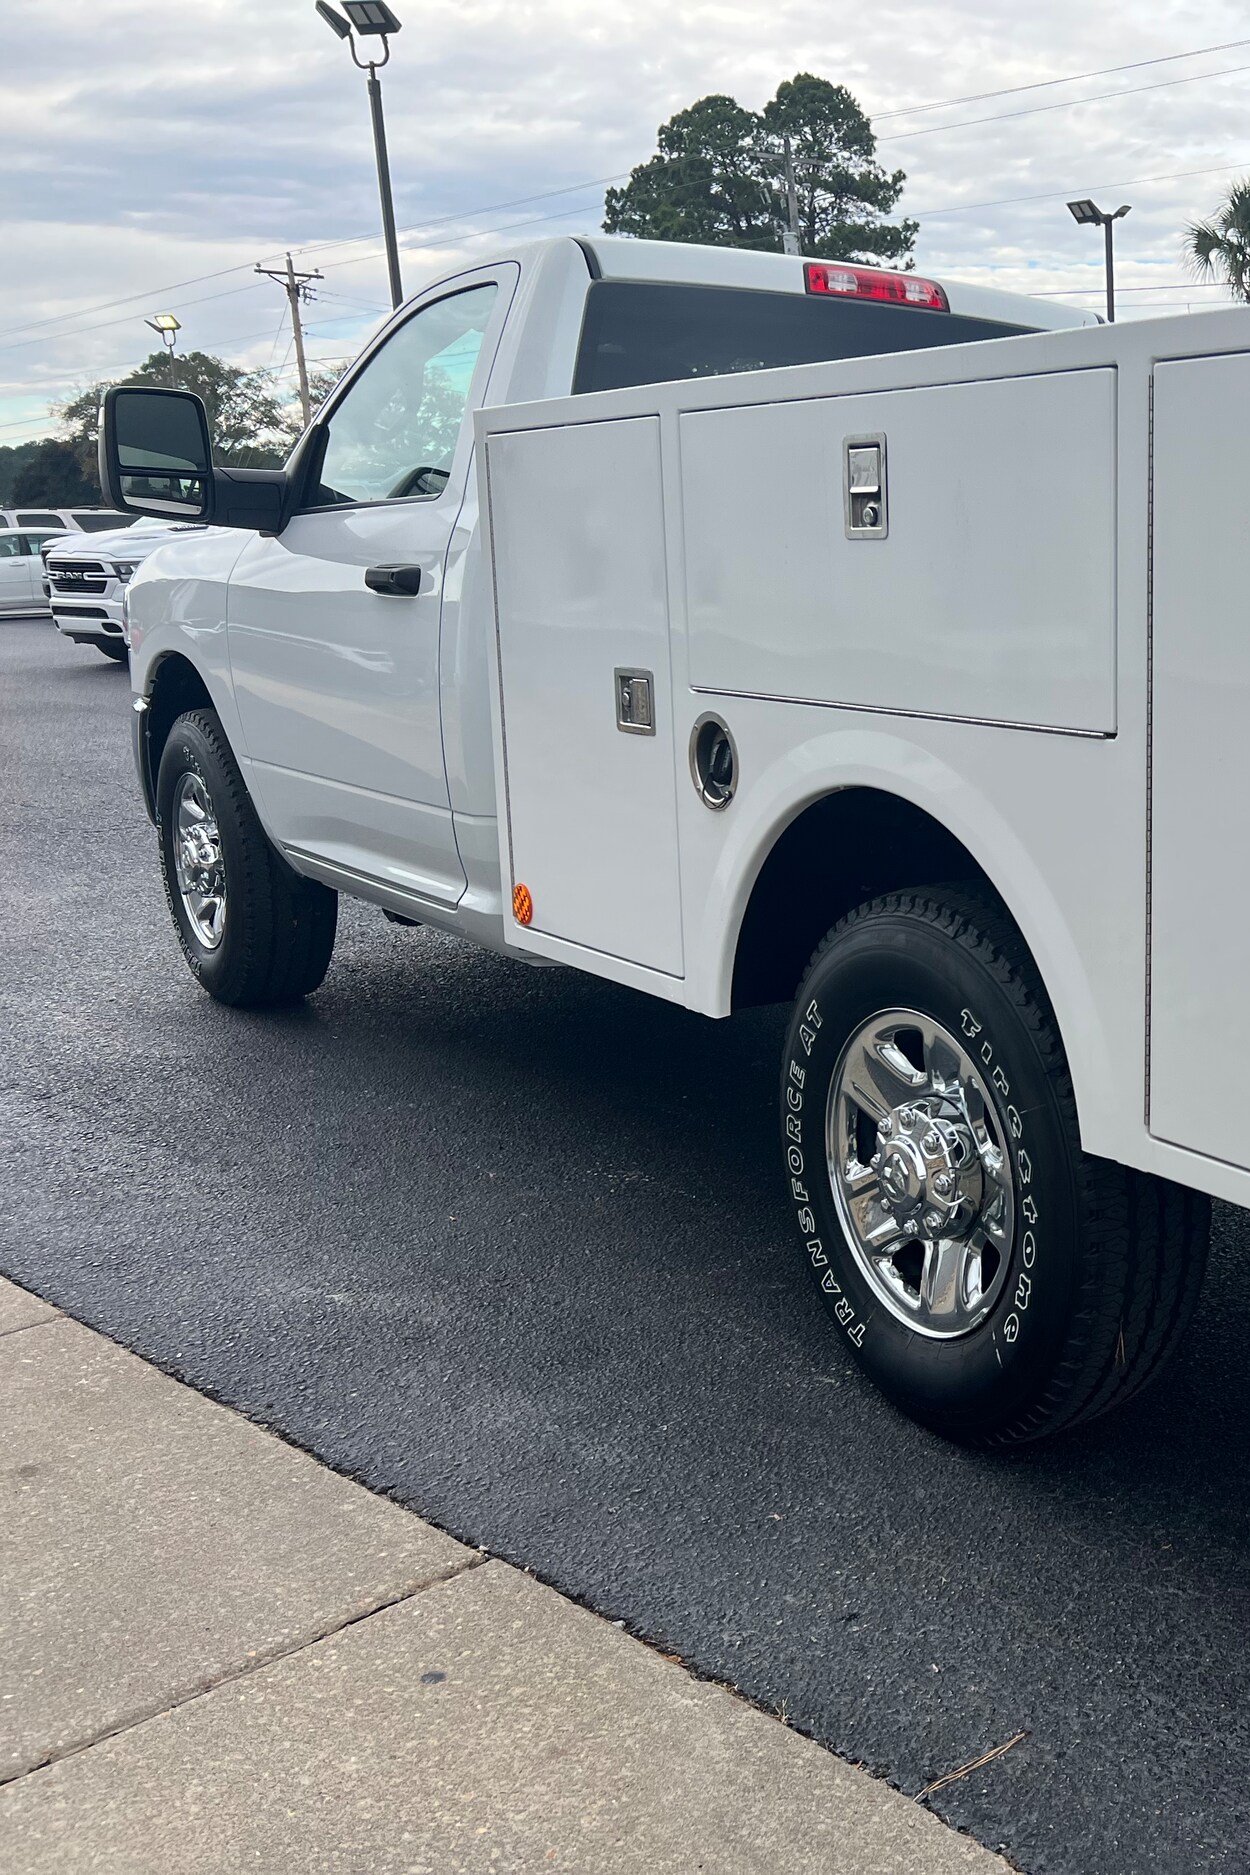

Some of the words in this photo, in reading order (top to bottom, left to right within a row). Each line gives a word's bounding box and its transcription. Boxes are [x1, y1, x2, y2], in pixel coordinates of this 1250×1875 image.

[57, 571, 83, 580] RAM
[799, 999, 825, 1056] AT
[786, 1059, 867, 1348] TRANSFORCE
